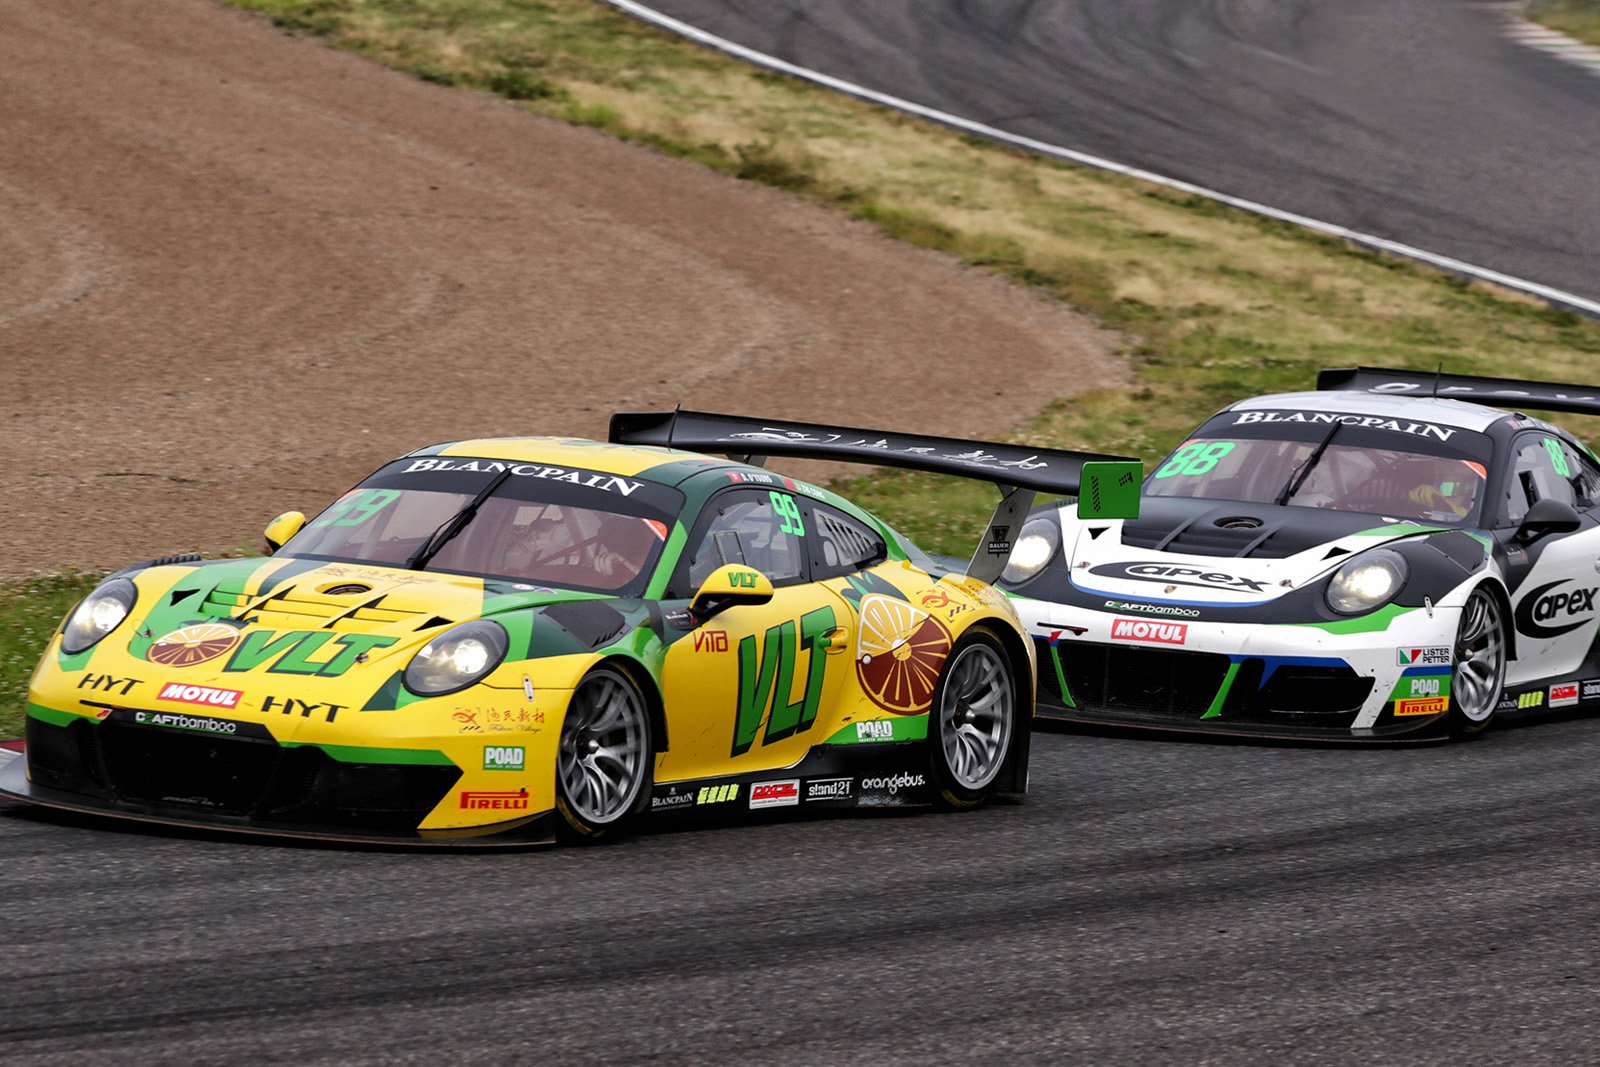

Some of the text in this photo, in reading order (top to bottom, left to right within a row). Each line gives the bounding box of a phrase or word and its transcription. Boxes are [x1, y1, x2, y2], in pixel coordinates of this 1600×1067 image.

[1233, 411, 1456, 441] BLANCPAIN
[1155, 442, 1237, 479] 88
[401, 459, 645, 497] BLANCPAIN
[769, 491, 806, 537] 99
[728, 572, 758, 588] VLT
[1128, 564, 1272, 593] apex
[1533, 587, 1599, 622] apex
[1114, 621, 1183, 641] MOTUL
[222, 630, 402, 678] VLT
[1422, 648, 1450, 656] LISTER
[1422, 655, 1450, 664] PETTER
[76, 672, 145, 696] HYT
[730, 604, 837, 759] VLT
[1410, 679, 1440, 694] POAD
[160, 684, 237, 706] MOTUL
[1400, 697, 1444, 714] PIRELLI
[260, 696, 350, 723] HYT
[856, 720, 893, 738] POAD
[485, 747, 524, 765] POAD
[460, 791, 529, 810] PIRELLI
[652, 792, 694, 807] BLANCPAIN
